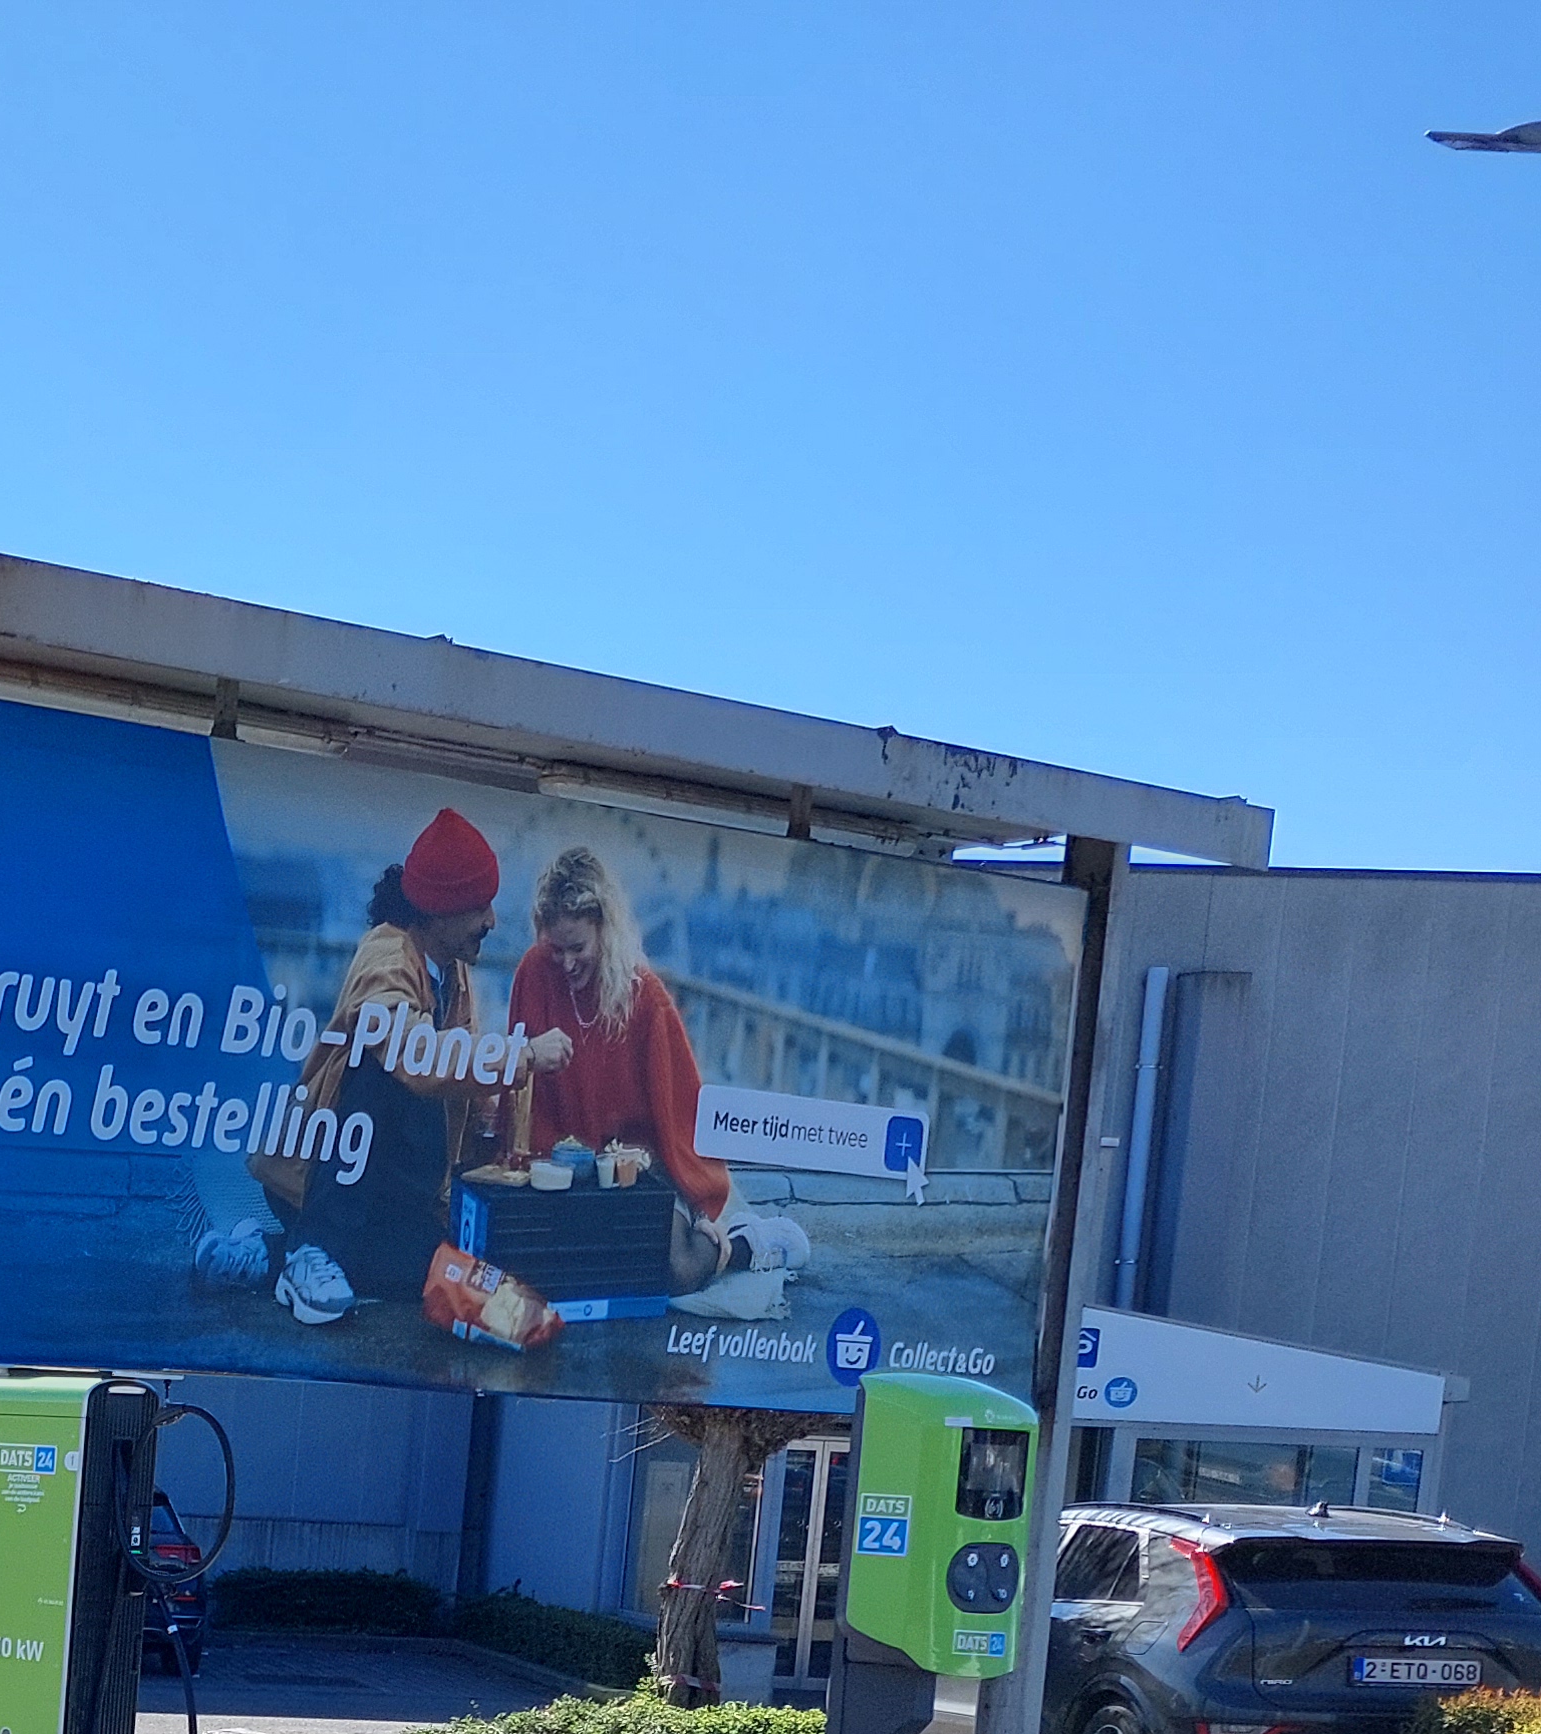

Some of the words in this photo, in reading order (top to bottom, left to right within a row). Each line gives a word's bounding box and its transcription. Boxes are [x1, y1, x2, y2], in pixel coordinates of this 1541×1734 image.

[132, 988, 203, 1048] en
[221, 984, 529, 1086] Bio-Planet
[90, 1063, 374, 1185] bestelling
[712, 1111, 759, 1135] Meer
[762, 1116, 790, 1142] tijd
[791, 1124, 824, 1144] met
[828, 1126, 868, 1149] twee
[666, 1325, 717, 1363] Leef
[718, 1328, 817, 1364] vollenbak
[888, 1341, 996, 1376] Collect&Go
[0, 1449, 33, 1467] DATS
[37, 1451, 53, 1469] 24
[865, 1499, 906, 1514] DATS
[862, 1520, 902, 1550] 24
[16, 1639, 45, 1663] kW
[957, 1634, 988, 1651] DATS
